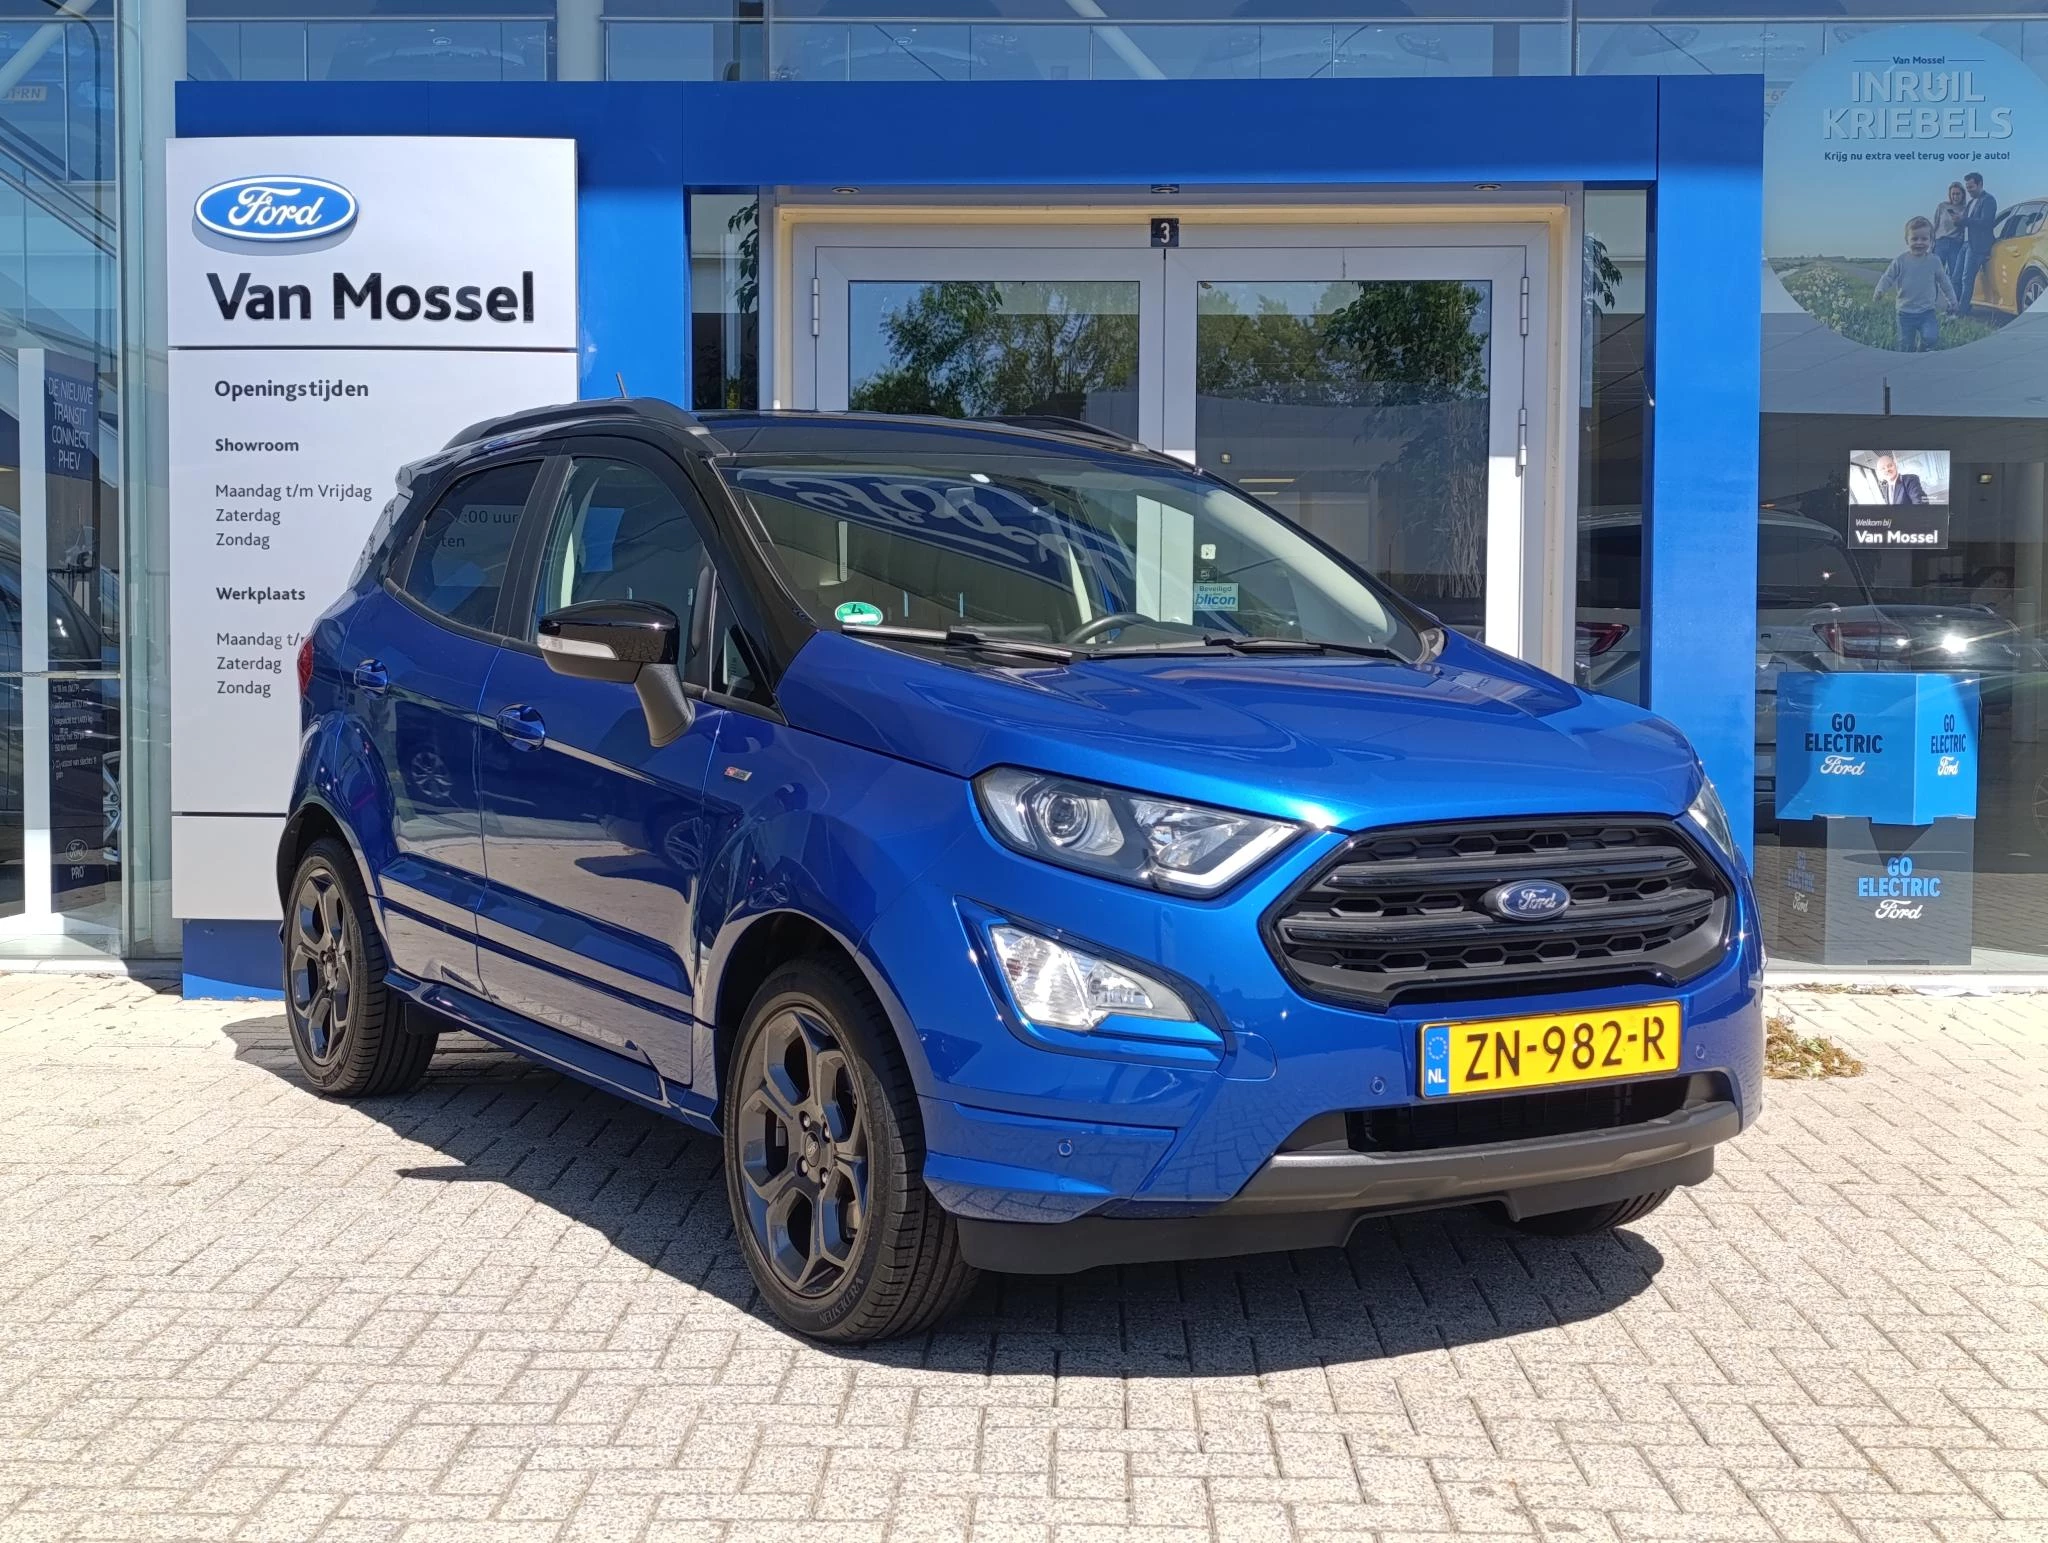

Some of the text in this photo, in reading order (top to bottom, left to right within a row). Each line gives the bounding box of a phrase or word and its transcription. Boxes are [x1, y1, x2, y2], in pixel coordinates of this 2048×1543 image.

[1892, 55, 1945, 65] Van Mossel
[1851, 70, 1986, 103] INRUIL
[1822, 106, 2014, 140] KRIEBELS
[1824, 152, 1848, 162] Krijg
[1850, 153, 1863, 161] nu
[1865, 153, 1892, 161] extra
[1894, 152, 1916, 161] veel
[1917, 152, 1945, 162] terug
[1972, 152, 1982, 161] je
[1984, 152, 2010, 160] auto!
[227, 186, 326, 227] Ford
[1160, 222, 1170, 244] 3
[206, 270, 535, 323] Van Mossel
[48, 376, 94, 405] DE NIEUWE
[214, 379, 370, 402] Openingstijden
[53, 401, 88, 427] TRANSIT
[51, 425, 91, 449] CONNECT
[215, 437, 300, 452] Showroom
[58, 449, 81, 471] PHEV
[215, 483, 373, 502] Maandag t/m Vrijdag
[215, 507, 282, 526] Zaterdag
[1855, 518, 1882, 527] Welkom
[215, 532, 271, 551] Zondag
[1855, 530, 1938, 543] Van Mossel
[216, 586, 306, 605] Werkplaats
[216, 632, 283, 650] Maandag
[216, 656, 283, 674] Zaterdag
[216, 680, 272, 698] Zondag
[1831, 713, 1856, 733] GO
[1943, 713, 1955, 733] GO
[1804, 733, 1884, 754] ELECTRIC
[1931, 733, 1967, 754] ELECTRIC
[1820, 755, 1866, 776] Ford
[1937, 756, 1959, 776] Ford
[71, 865, 85, 880] PRO
[1887, 856, 1913, 877] GO
[1858, 877, 1941, 897] ELECTRIC
[1518, 888, 1557, 911] Ford
[1875, 899, 1924, 919] Ford
[1465, 1015, 1666, 1082] ZN-982-R
[1427, 1068, 1446, 1085] NL
